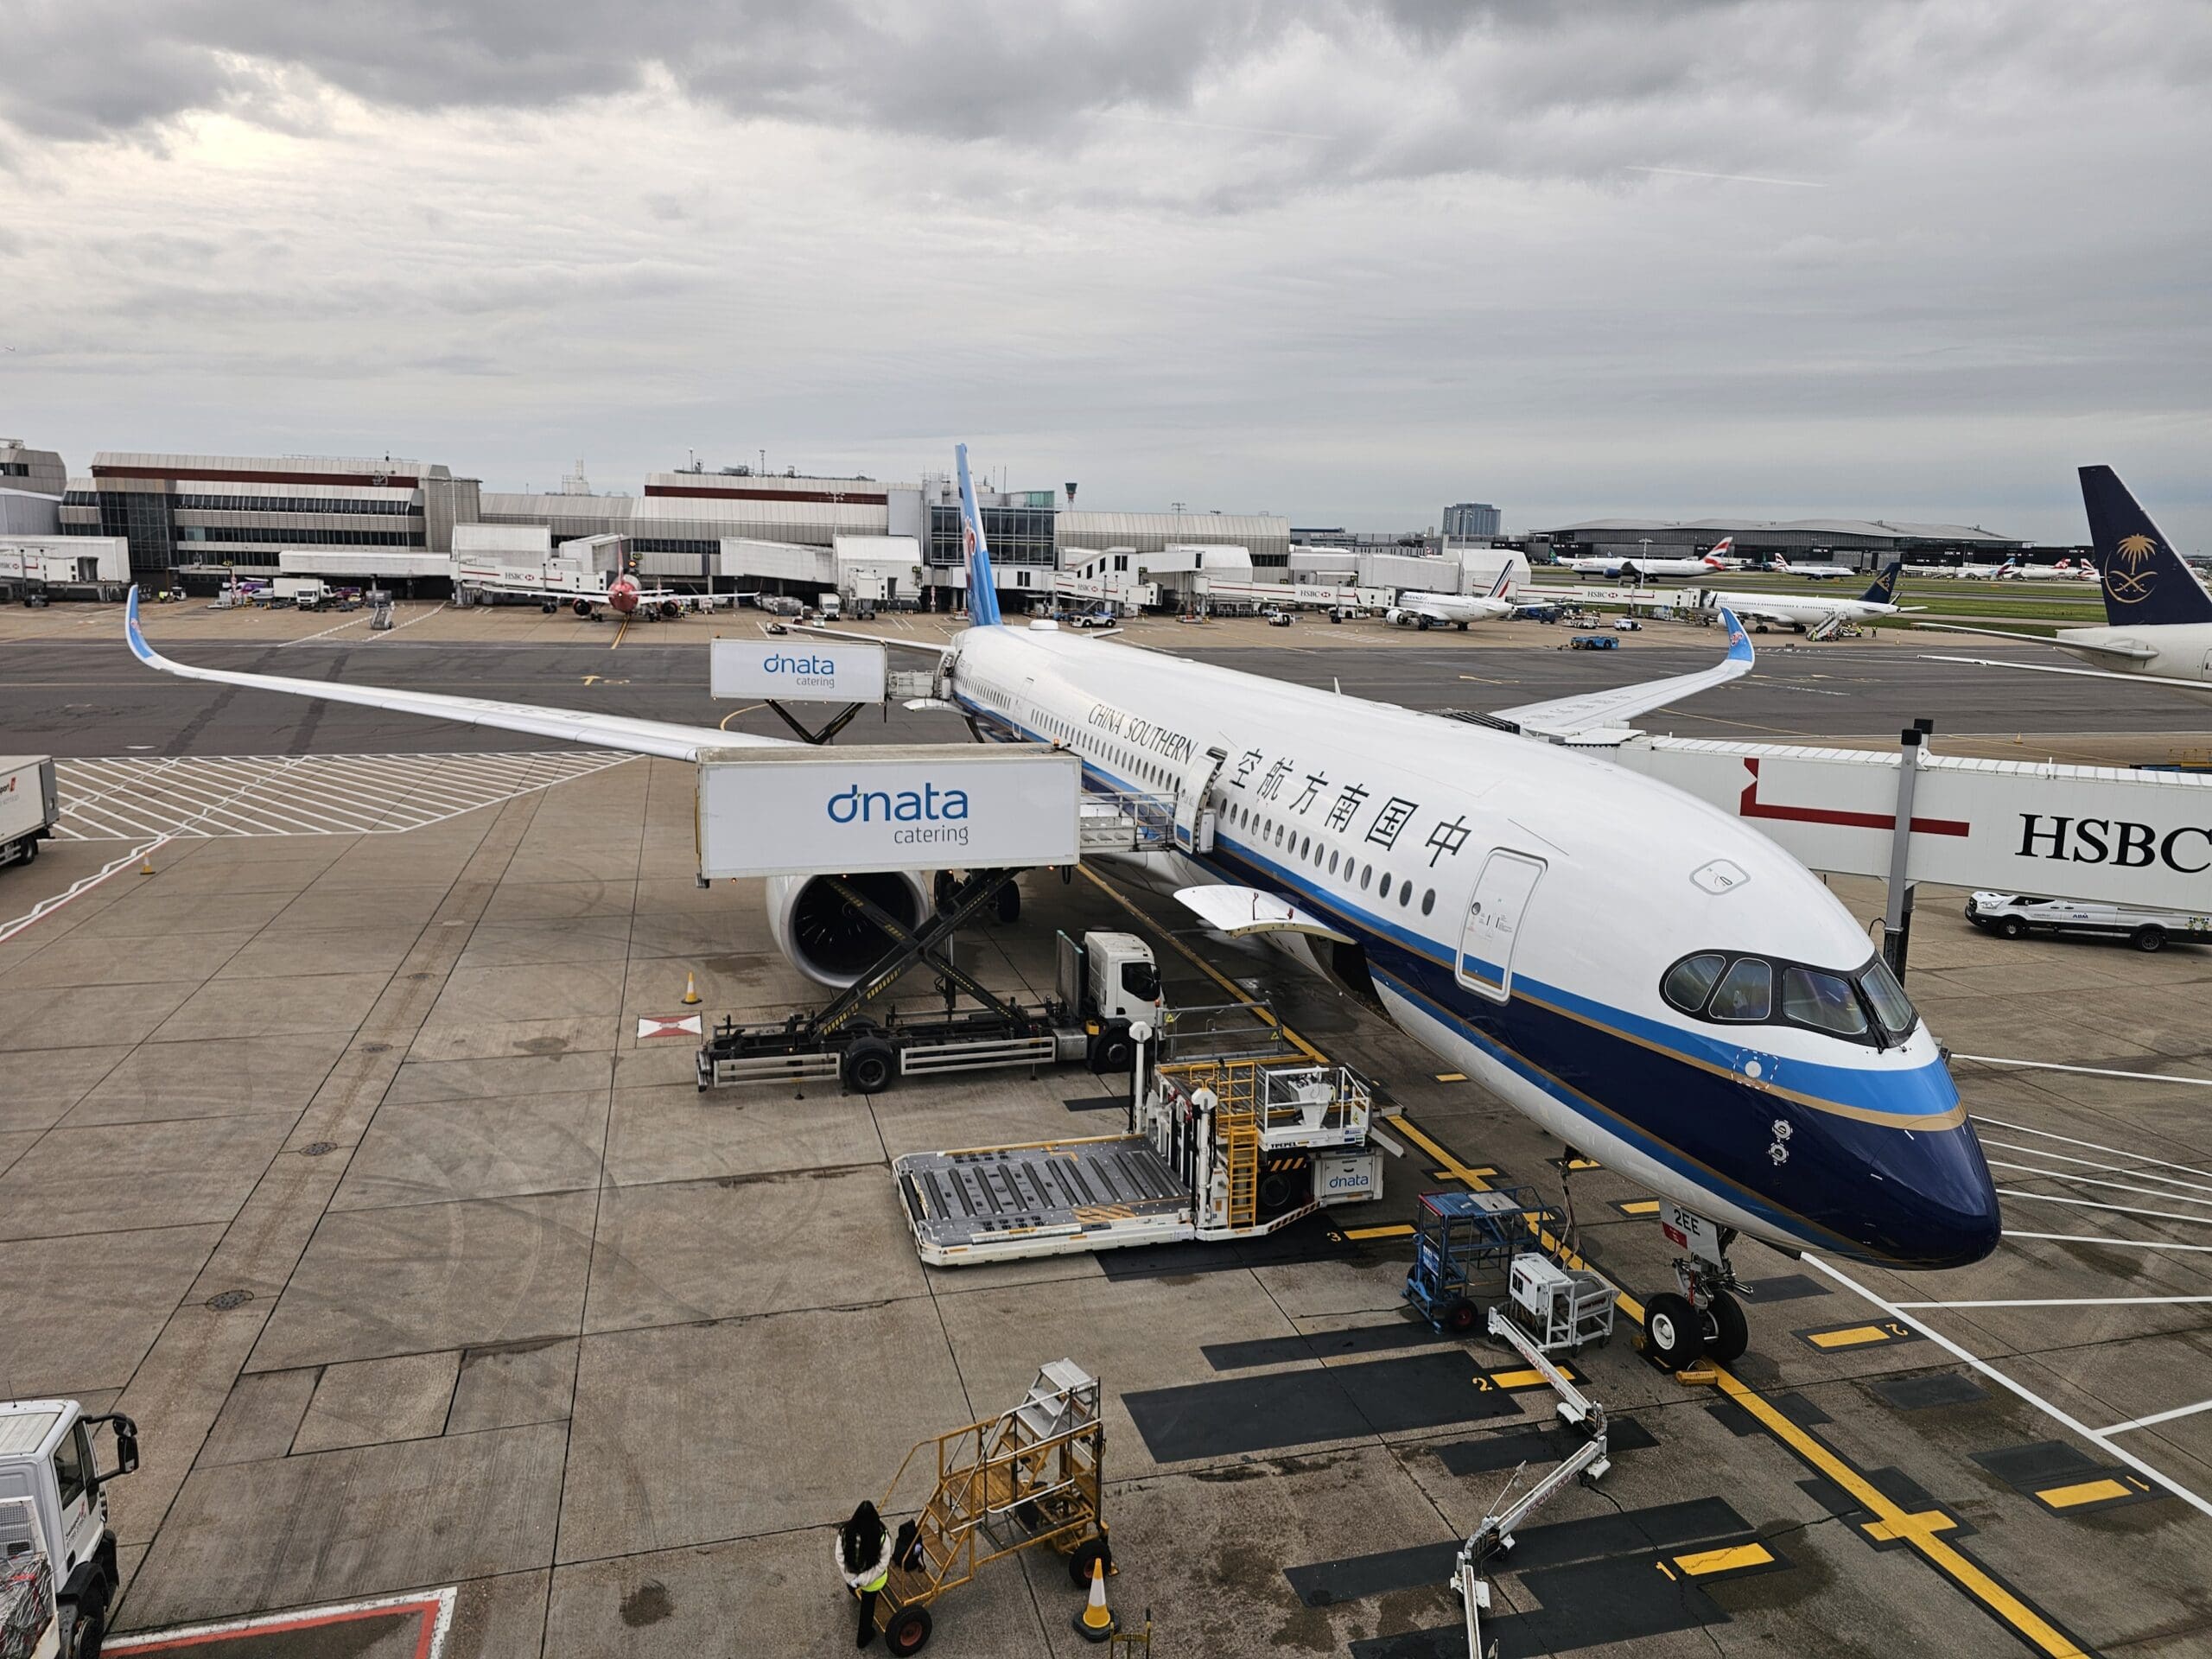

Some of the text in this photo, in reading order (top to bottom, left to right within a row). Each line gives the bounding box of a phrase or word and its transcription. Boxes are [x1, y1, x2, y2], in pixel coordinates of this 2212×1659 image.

[505, 572, 524, 581] HSBC
[764, 653, 835, 675] dnata
[797, 677, 835, 690] catering
[1089, 703, 1198, 765] CHINA SOUTHERN
[827, 782, 969, 823] dnata
[893, 824, 969, 846] catering
[2014, 813, 2212, 874] HSBC
[1329, 1175, 1369, 1188] dnata
[1674, 1209, 1700, 1236] 2EE
[1327, 1231, 1342, 1242] 3
[1885, 1323, 1909, 1336] 2
[1472, 1377, 1493, 1391] 2
[1656, 1561, 1677, 1581] 1
